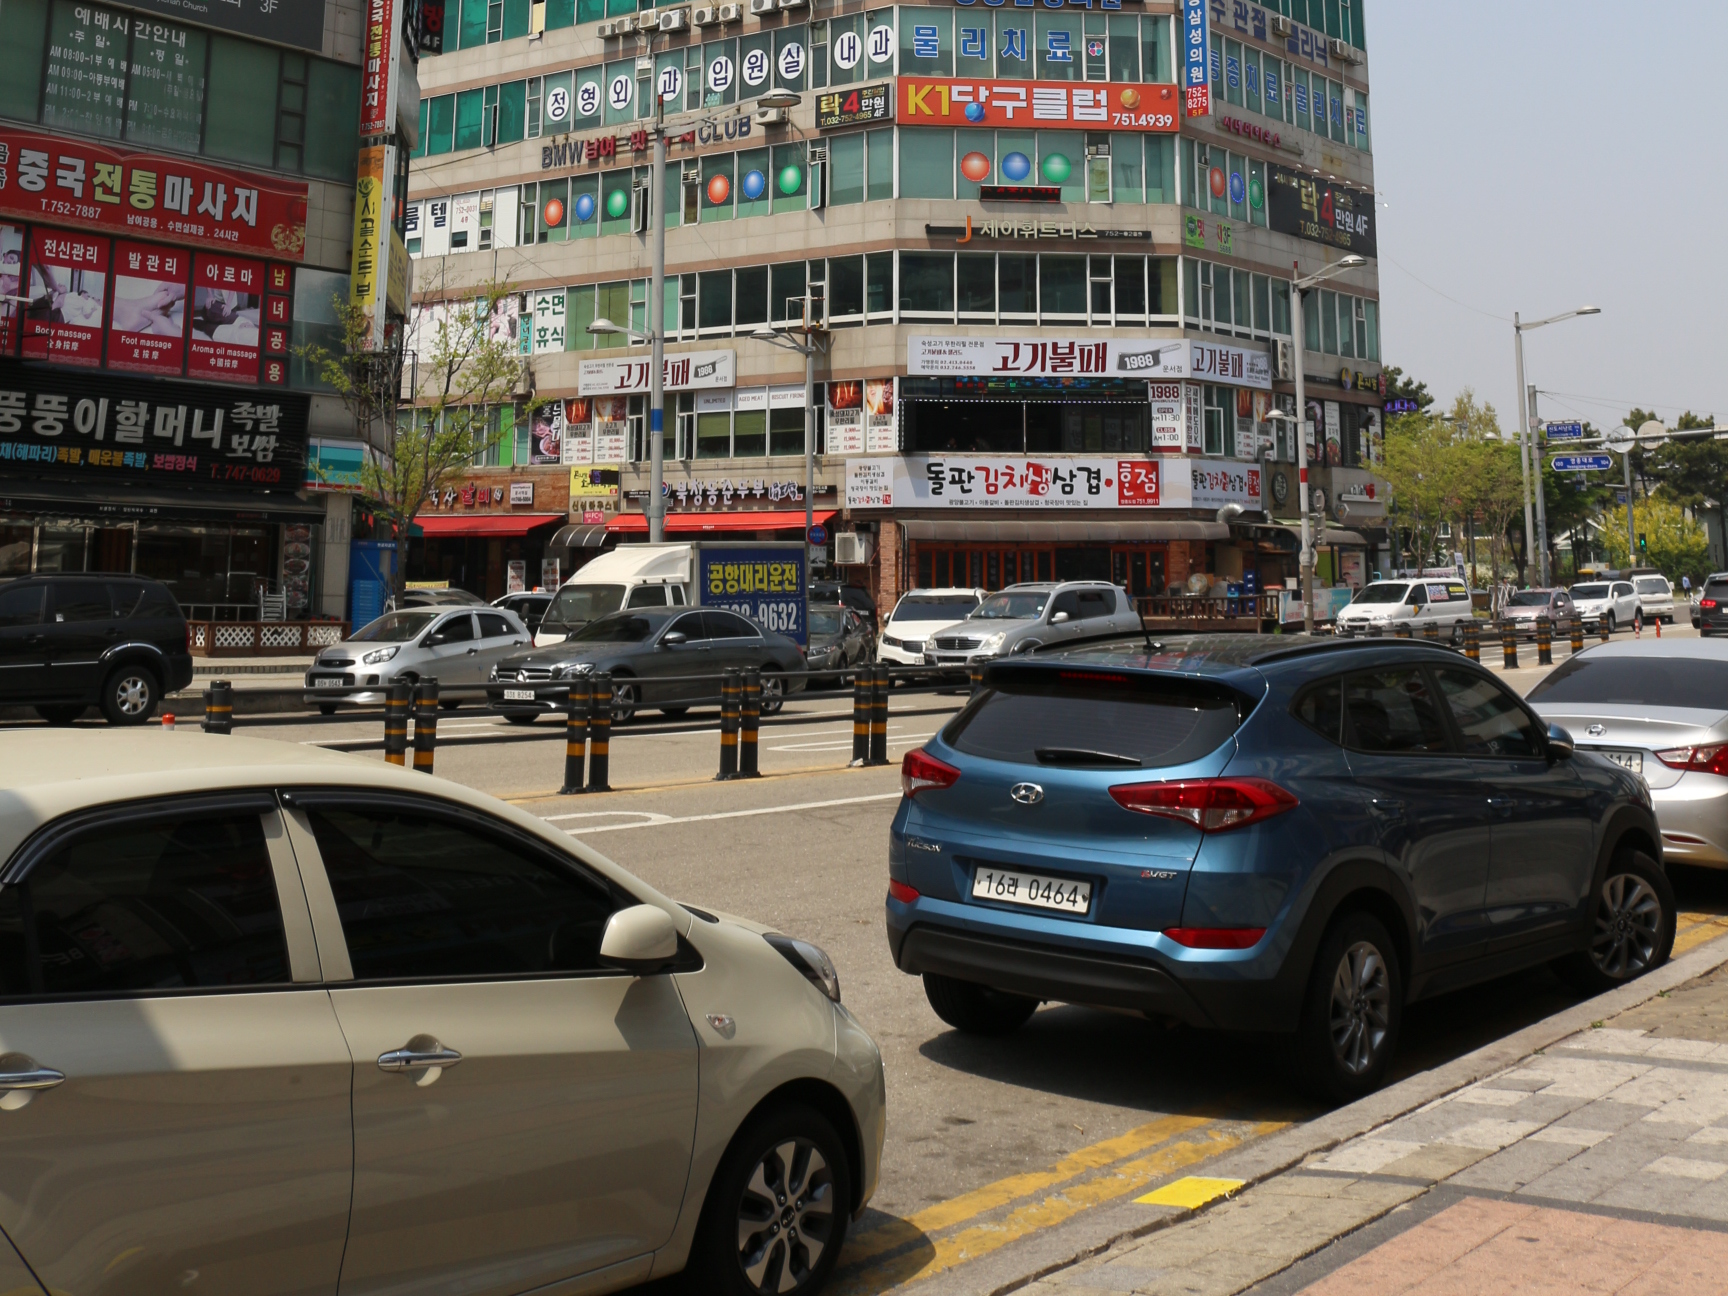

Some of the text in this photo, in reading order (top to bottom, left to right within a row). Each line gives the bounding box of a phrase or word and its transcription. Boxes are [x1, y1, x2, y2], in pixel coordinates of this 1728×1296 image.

[182, 0, 208, 13] Church
[50, 46, 61, 57] AM
[423, 35, 440, 48] 4F
[912, 24, 1073, 62] 물리치료
[48, 64, 59, 76] AM
[550, 27, 891, 119] 정형외과 입원실 내과
[46, 83, 57, 95] AM
[1187, 86, 1207, 99] 752-
[820, 93, 843, 116] 락
[873, 108, 885, 117] 4F
[1187, 97, 1208, 110] 8275
[1192, 107, 1204, 117] 5F
[1296, 83, 1367, 136] 물리치료
[1112, 112, 1173, 128] 751.4939
[541, 140, 584, 169] BMW
[697, 115, 752, 145] CLUB
[17, 148, 258, 227] 중국전통마사지
[40, 198, 101, 219] T.752-7887
[126, 214, 157, 229] 남여공용
[213, 228, 239, 241] 24시간
[980, 218, 1098, 240] 제이휘트니스
[1355, 214, 1368, 236] 4F
[44, 239, 98, 264] 전신관리
[205, 263, 254, 287] 아로마
[536, 294, 565, 317] 수면
[35, 325, 92, 341] Body massage
[120, 336, 172, 350] Foot massage
[536, 325, 565, 348] 휴식
[191, 344, 258, 359] Aroma oil massage
[991, 341, 1183, 374] 고기불패 1988 운서점
[1192, 346, 1243, 379] 고기불패
[1150, 385, 1180, 399] 1988
[230, 402, 283, 432] 족발
[1160, 413, 1180, 422] 11:30
[1162, 433, 1179, 441] 1:00
[226, 435, 280, 463] 보쌈
[152, 453, 198, 472] 보쌈정식
[224, 464, 282, 482] 747-0629
[926, 461, 1102, 497] 돌판김치생삼겹
[676, 478, 765, 507] 북창동순두부
[709, 563, 797, 594] 공항대리운전
[906, 837, 942, 853] TUCSON
[986, 872, 1079, 908] 16라 0464
